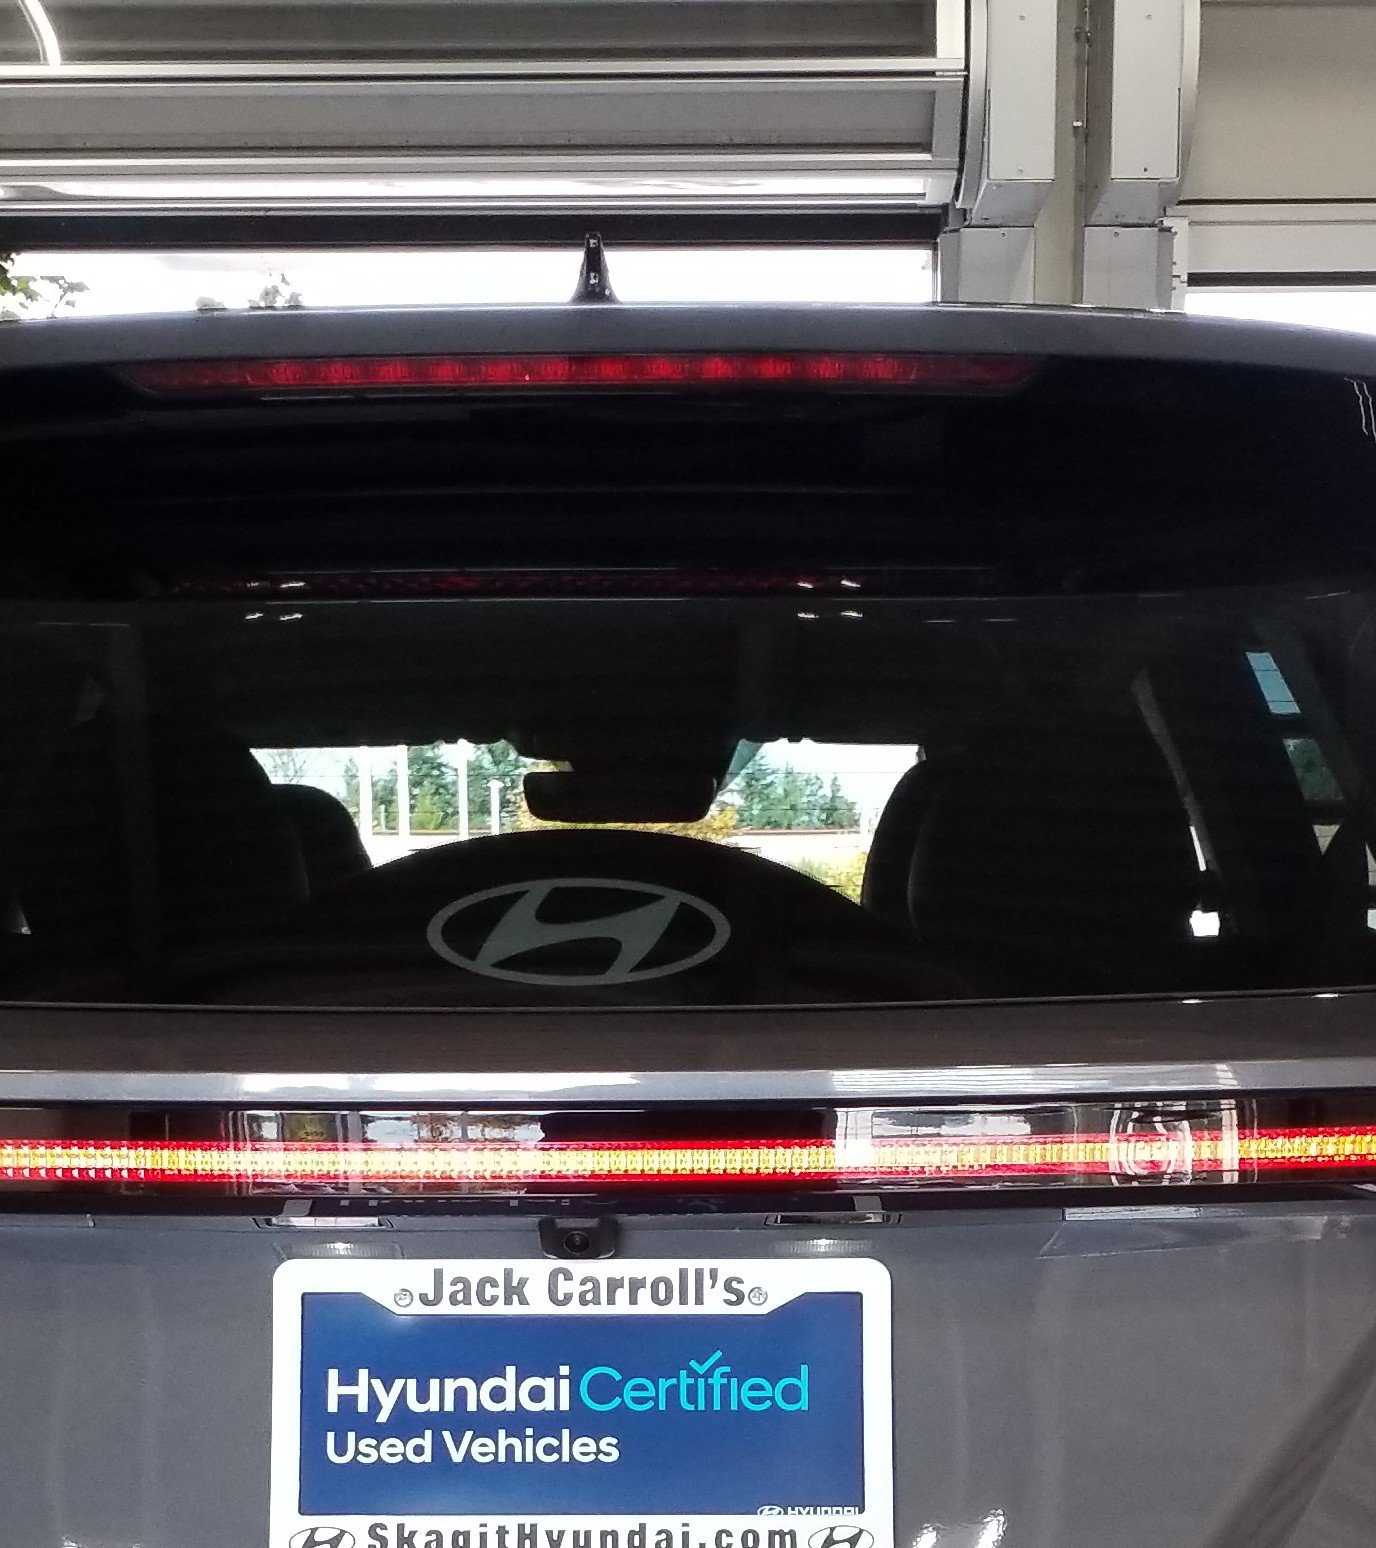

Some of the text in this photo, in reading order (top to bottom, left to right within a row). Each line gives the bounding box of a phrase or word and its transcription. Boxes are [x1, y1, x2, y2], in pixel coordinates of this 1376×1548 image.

[419, 1266, 745, 1306] Jack Carroll's
[326, 1350, 809, 1422] Hyundai Certified
[326, 1428, 620, 1464] Used Vehicles
